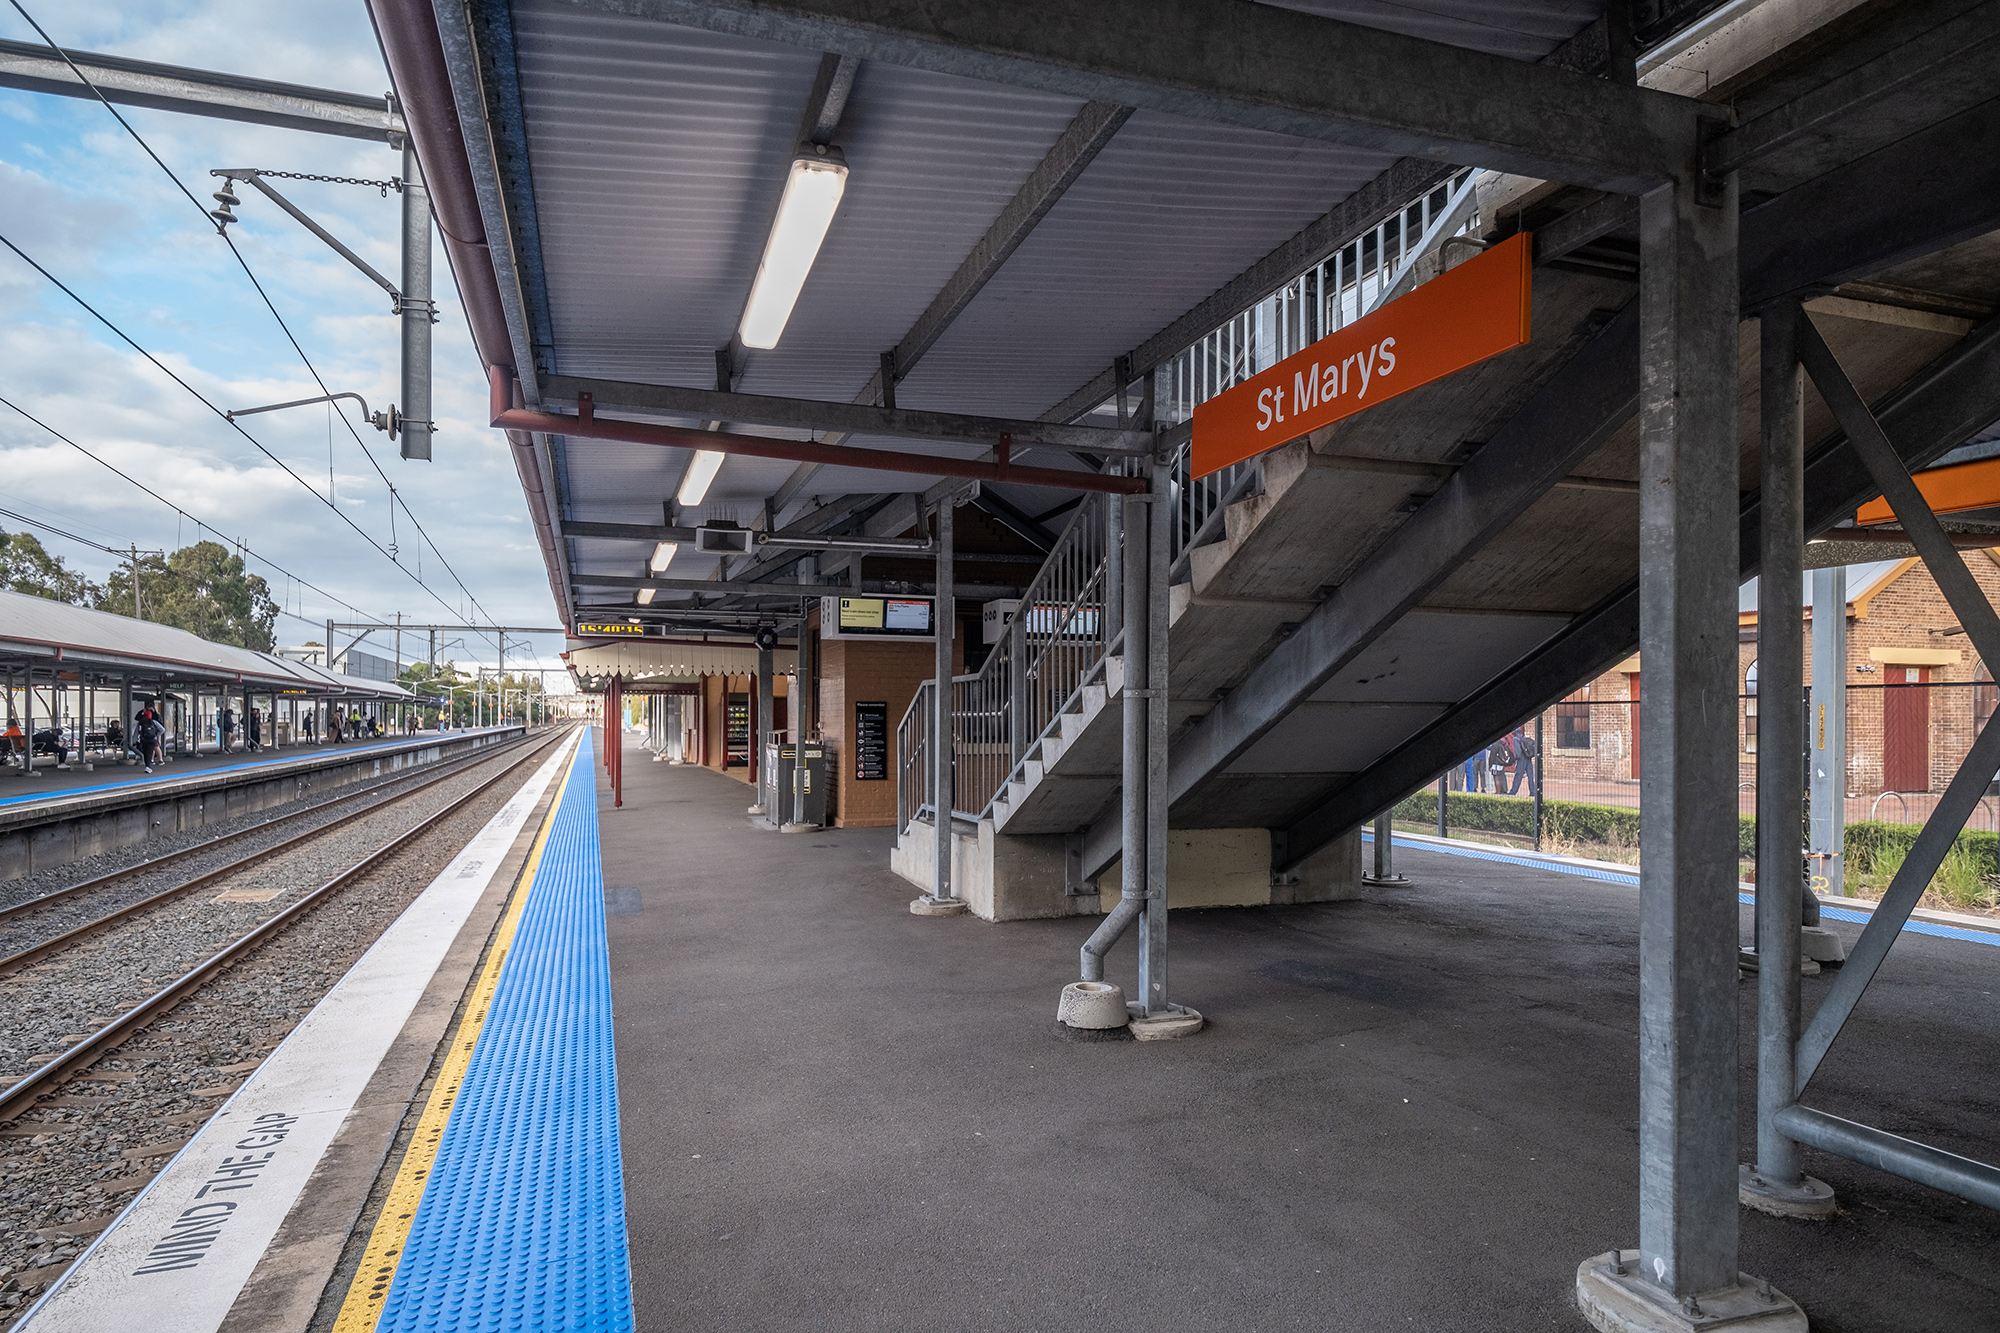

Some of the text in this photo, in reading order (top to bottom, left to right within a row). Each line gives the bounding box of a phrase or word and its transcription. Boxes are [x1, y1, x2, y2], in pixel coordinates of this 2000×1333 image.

[1256, 336, 1396, 432] St Marys
[132, 1112, 299, 1276] MIND THE GAP
